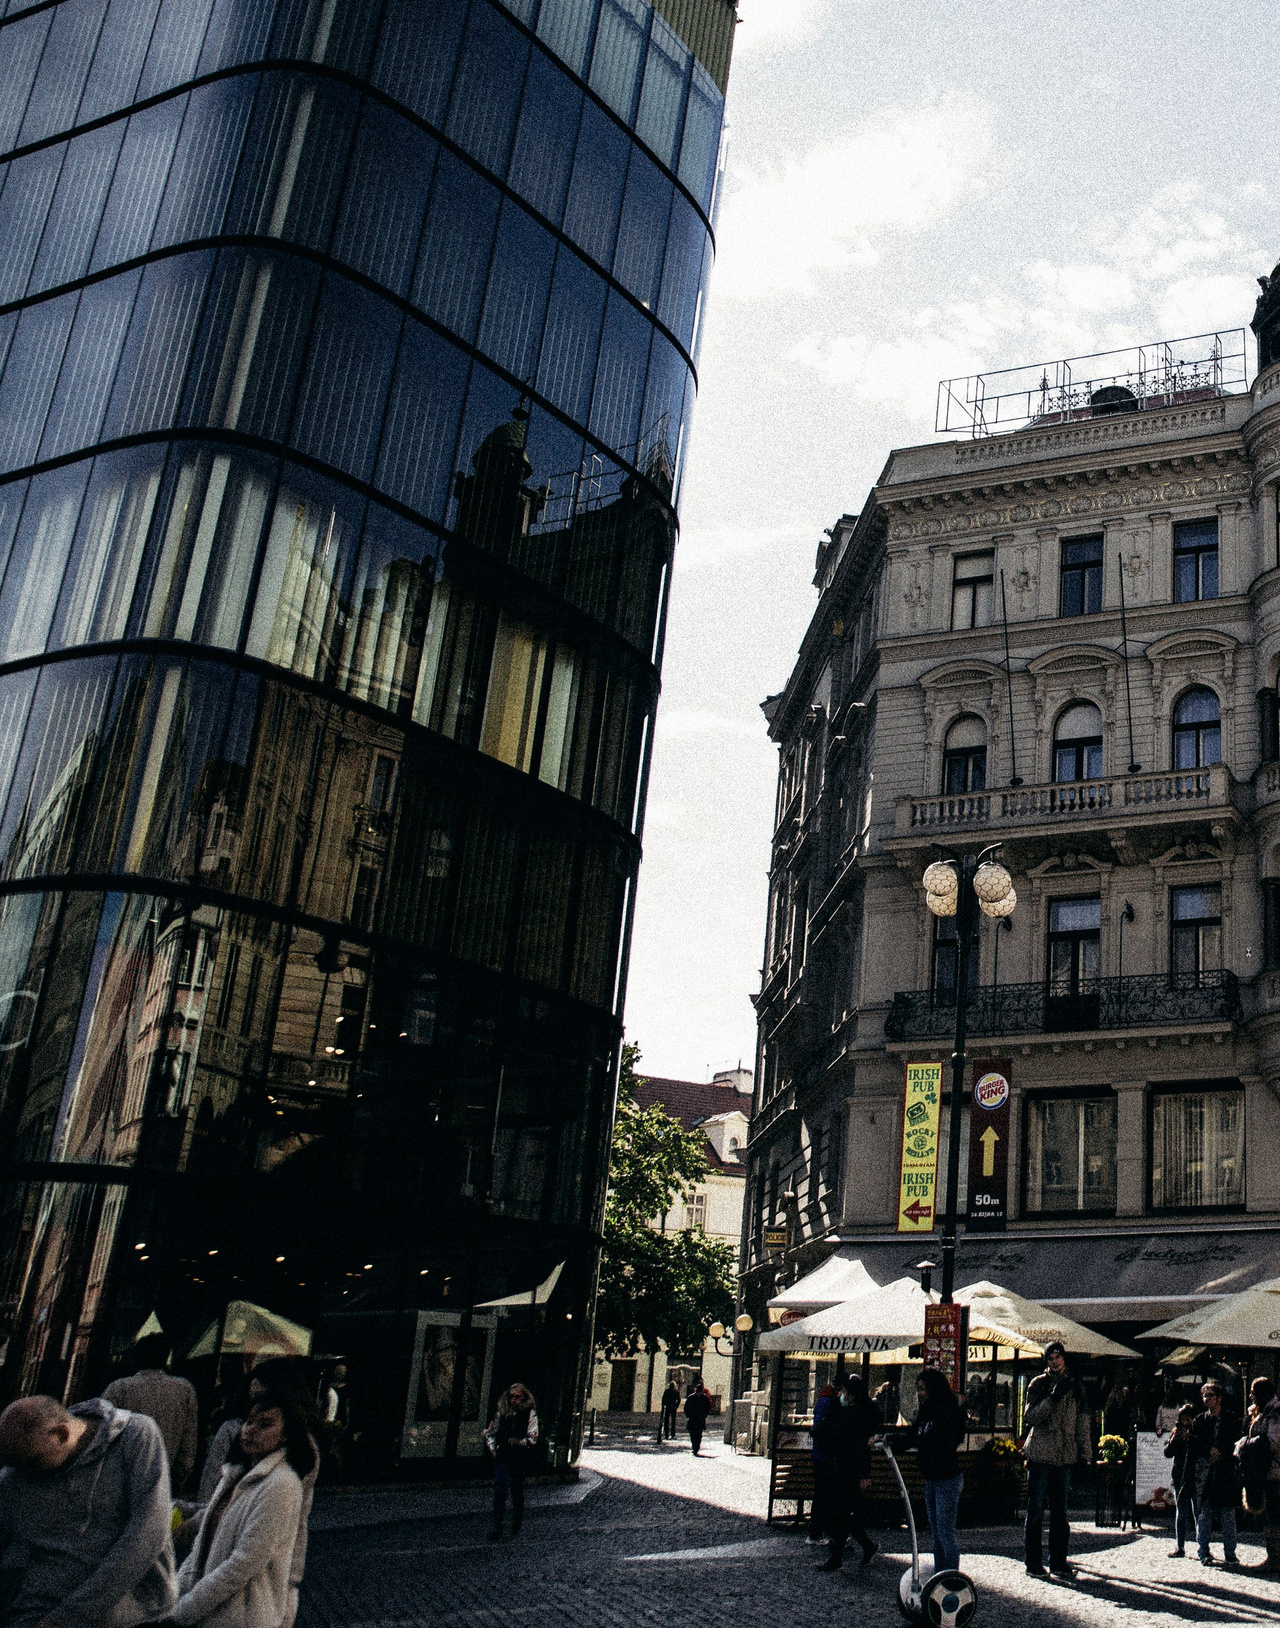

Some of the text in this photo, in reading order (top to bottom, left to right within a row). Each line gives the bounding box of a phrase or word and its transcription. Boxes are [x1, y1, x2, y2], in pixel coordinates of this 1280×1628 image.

[908, 1068, 940, 1081] IRISH
[912, 1081, 934, 1093] PUB
[979, 1079, 1005, 1093] BURGER
[980, 1086, 1006, 1102] KING
[902, 1172, 934, 1185] IRISH
[906, 1185, 928, 1198] PUB
[975, 1194, 1000, 1206] 50m
[807, 1334, 894, 1351] TRDELNÍK
